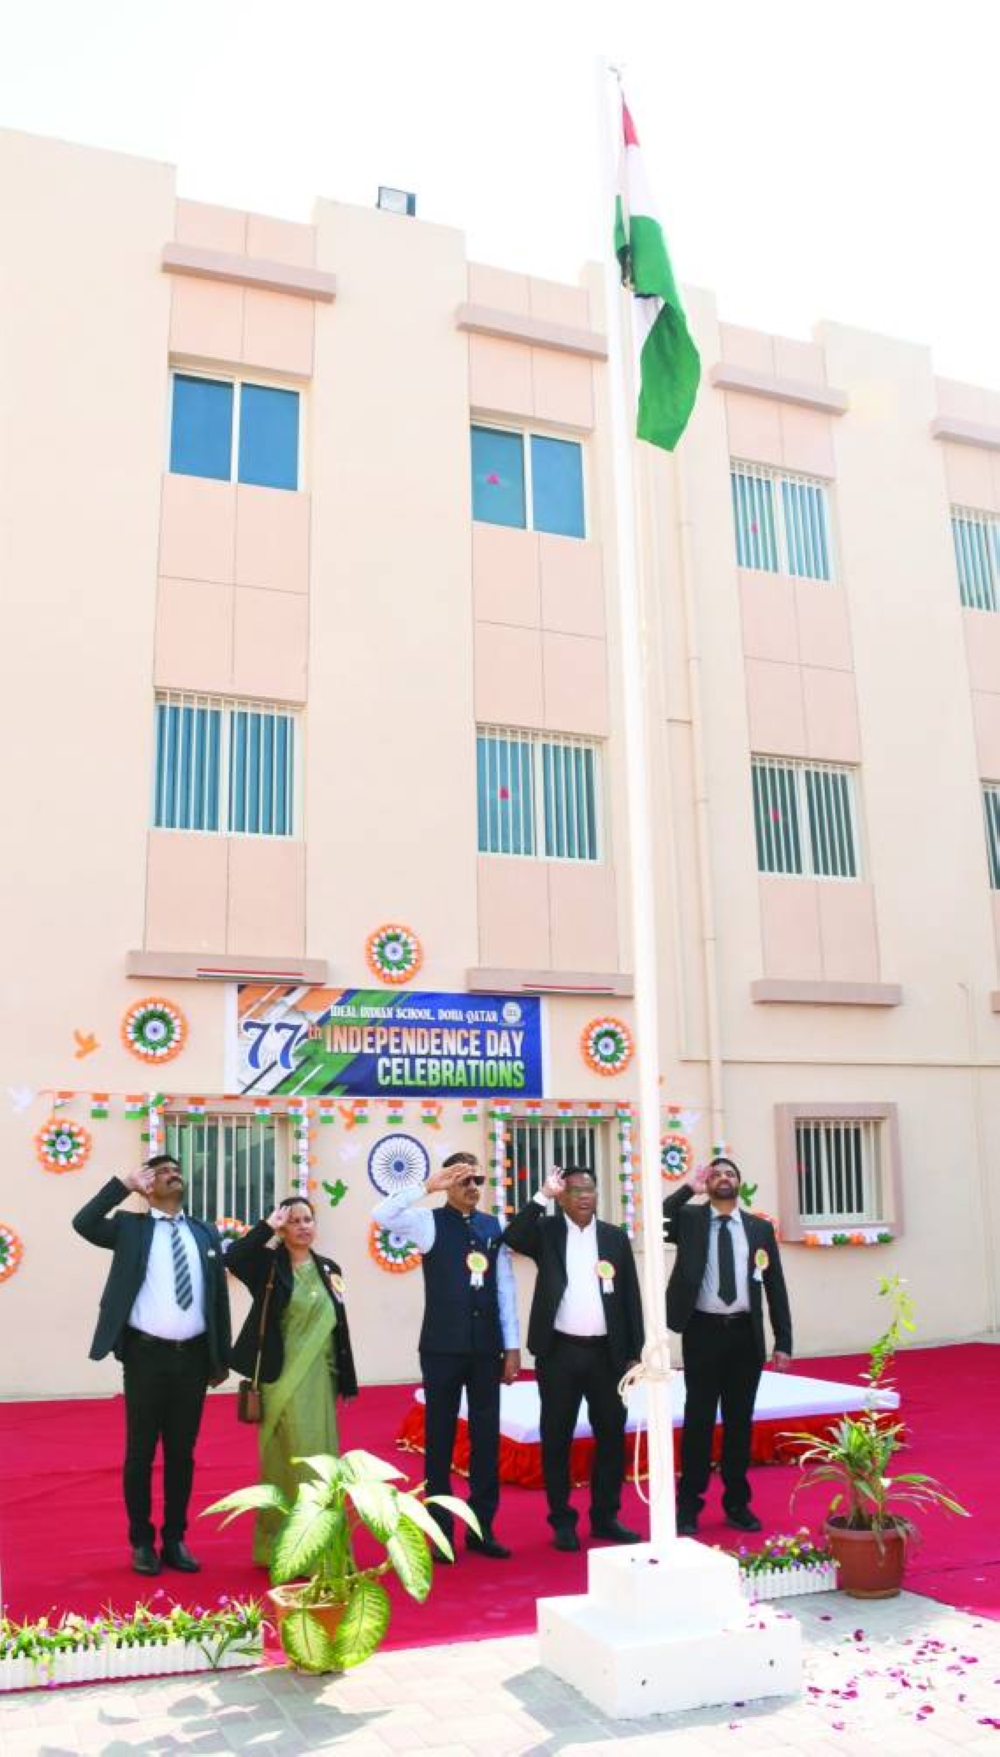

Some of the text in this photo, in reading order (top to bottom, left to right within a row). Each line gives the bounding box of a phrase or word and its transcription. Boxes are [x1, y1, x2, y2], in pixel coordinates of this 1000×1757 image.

[331, 1005, 357, 1018] IDEAL
[360, 1006, 393, 1019] INDIAN
[325, 1024, 482, 1057] INDEPENDENCE
[486, 1029, 524, 1058] DAY
[377, 1056, 526, 1088] CELEBRATIONS
